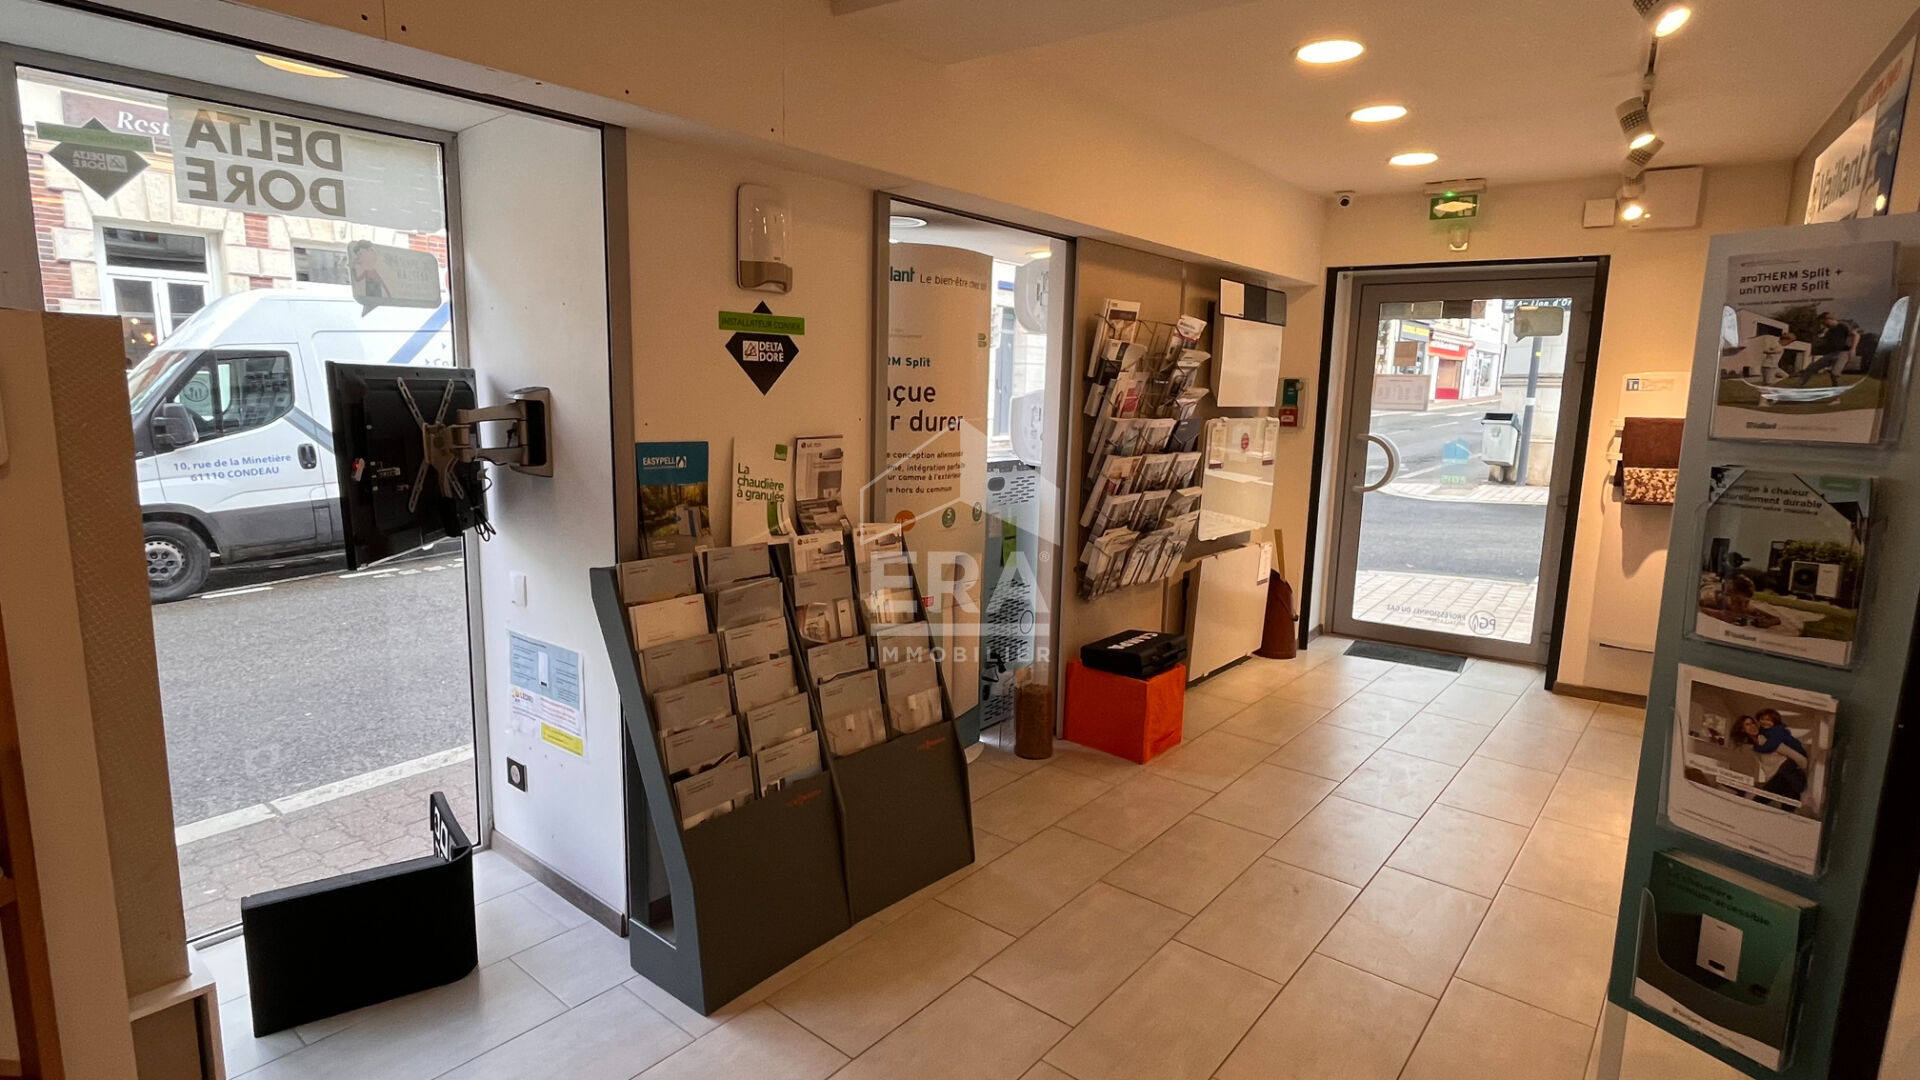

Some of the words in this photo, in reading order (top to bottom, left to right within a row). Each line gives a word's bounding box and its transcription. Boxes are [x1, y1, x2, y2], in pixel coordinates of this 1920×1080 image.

[920, 273, 932, 284] Le
[1739, 270, 1798, 283] aroTHERM
[1801, 267, 1830, 280] Split
[1739, 282, 1797, 295] uniTOWER
[1800, 280, 1829, 292] Split
[759, 341, 784, 352] DELTA
[759, 352, 784, 363] DORE
[906, 357, 931, 368] Split
[909, 409, 963, 432] durer
[174, 462, 191, 471] 10,
[193, 461, 212, 469] rue
[214, 459, 227, 468] de
[230, 458, 240, 466] la
[242, 454, 291, 465] Minetière
[643, 455, 676, 466] EASYPELL
[190, 471, 225, 481] 61110
[227, 466, 280, 479] CONDEAU
[737, 463, 750, 474] La
[737, 475, 784, 490] chaudière
[737, 488, 744, 498] à
[745, 489, 785, 502] granulés
[1771, 487, 1809, 496] chaleur
[1783, 498, 1822, 508] durable
